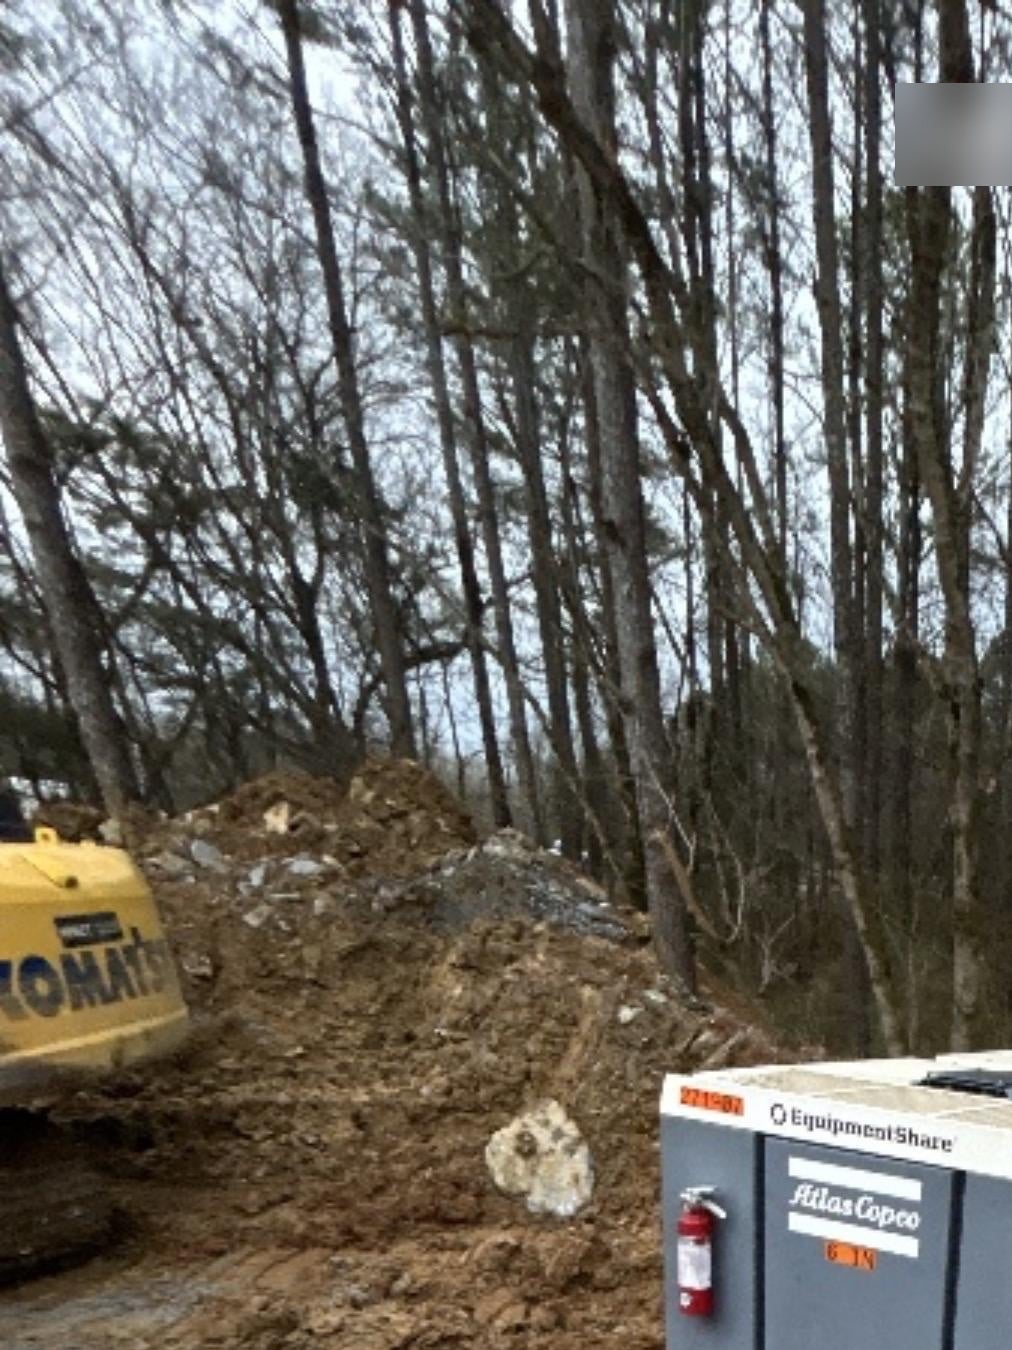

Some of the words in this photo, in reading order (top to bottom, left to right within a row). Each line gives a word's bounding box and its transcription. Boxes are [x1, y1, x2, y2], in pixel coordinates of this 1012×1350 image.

[791, 1106, 953, 1153] EquipmentShare
[789, 1183, 853, 1217] Atlas
[854, 1194, 920, 1230] Copco
